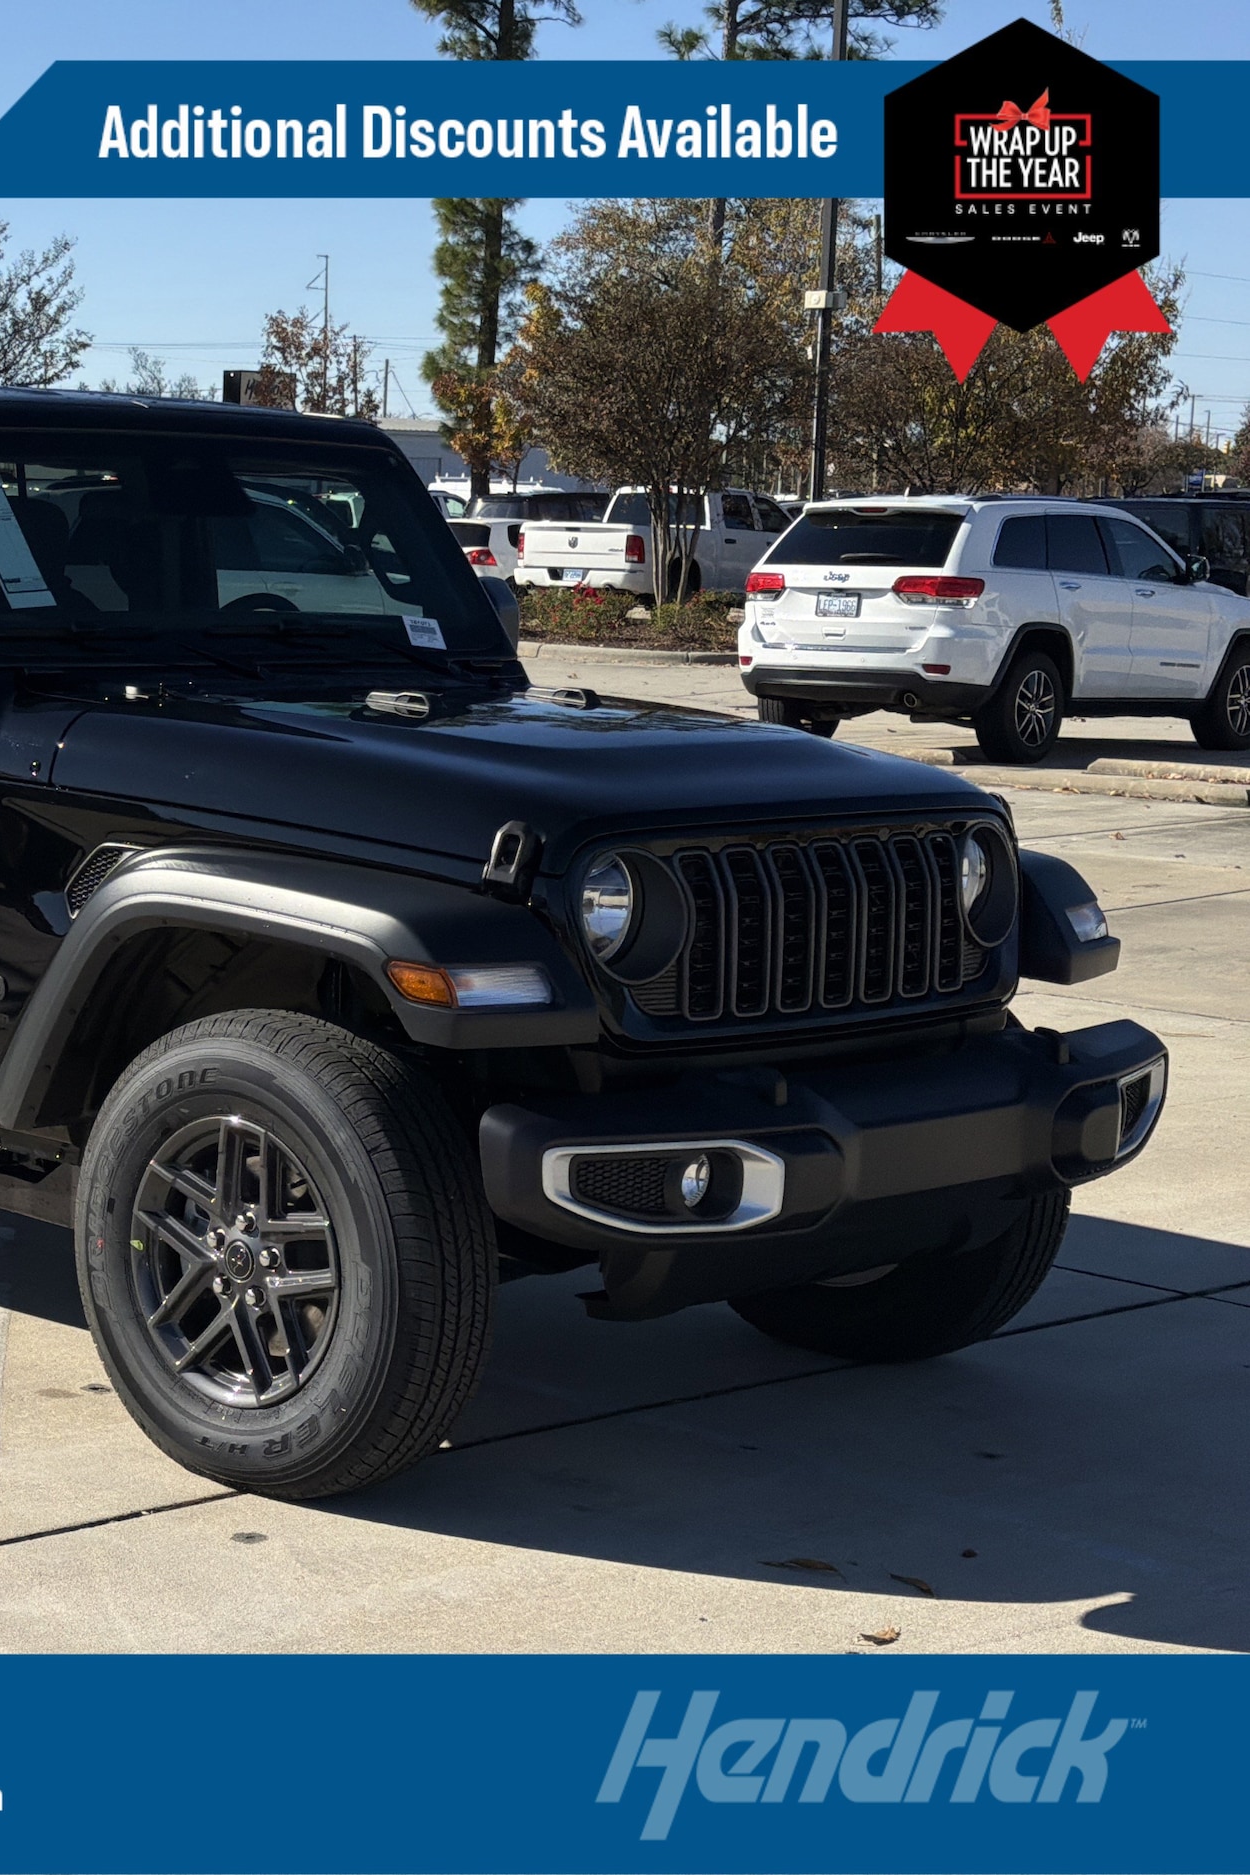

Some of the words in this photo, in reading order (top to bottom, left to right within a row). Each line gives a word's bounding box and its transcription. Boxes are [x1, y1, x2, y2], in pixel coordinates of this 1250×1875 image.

[823, 571, 850, 583] Jeep
[87, 1066, 221, 1308] BRIDGESTONE
[195, 1436, 248, 1455] H/T
